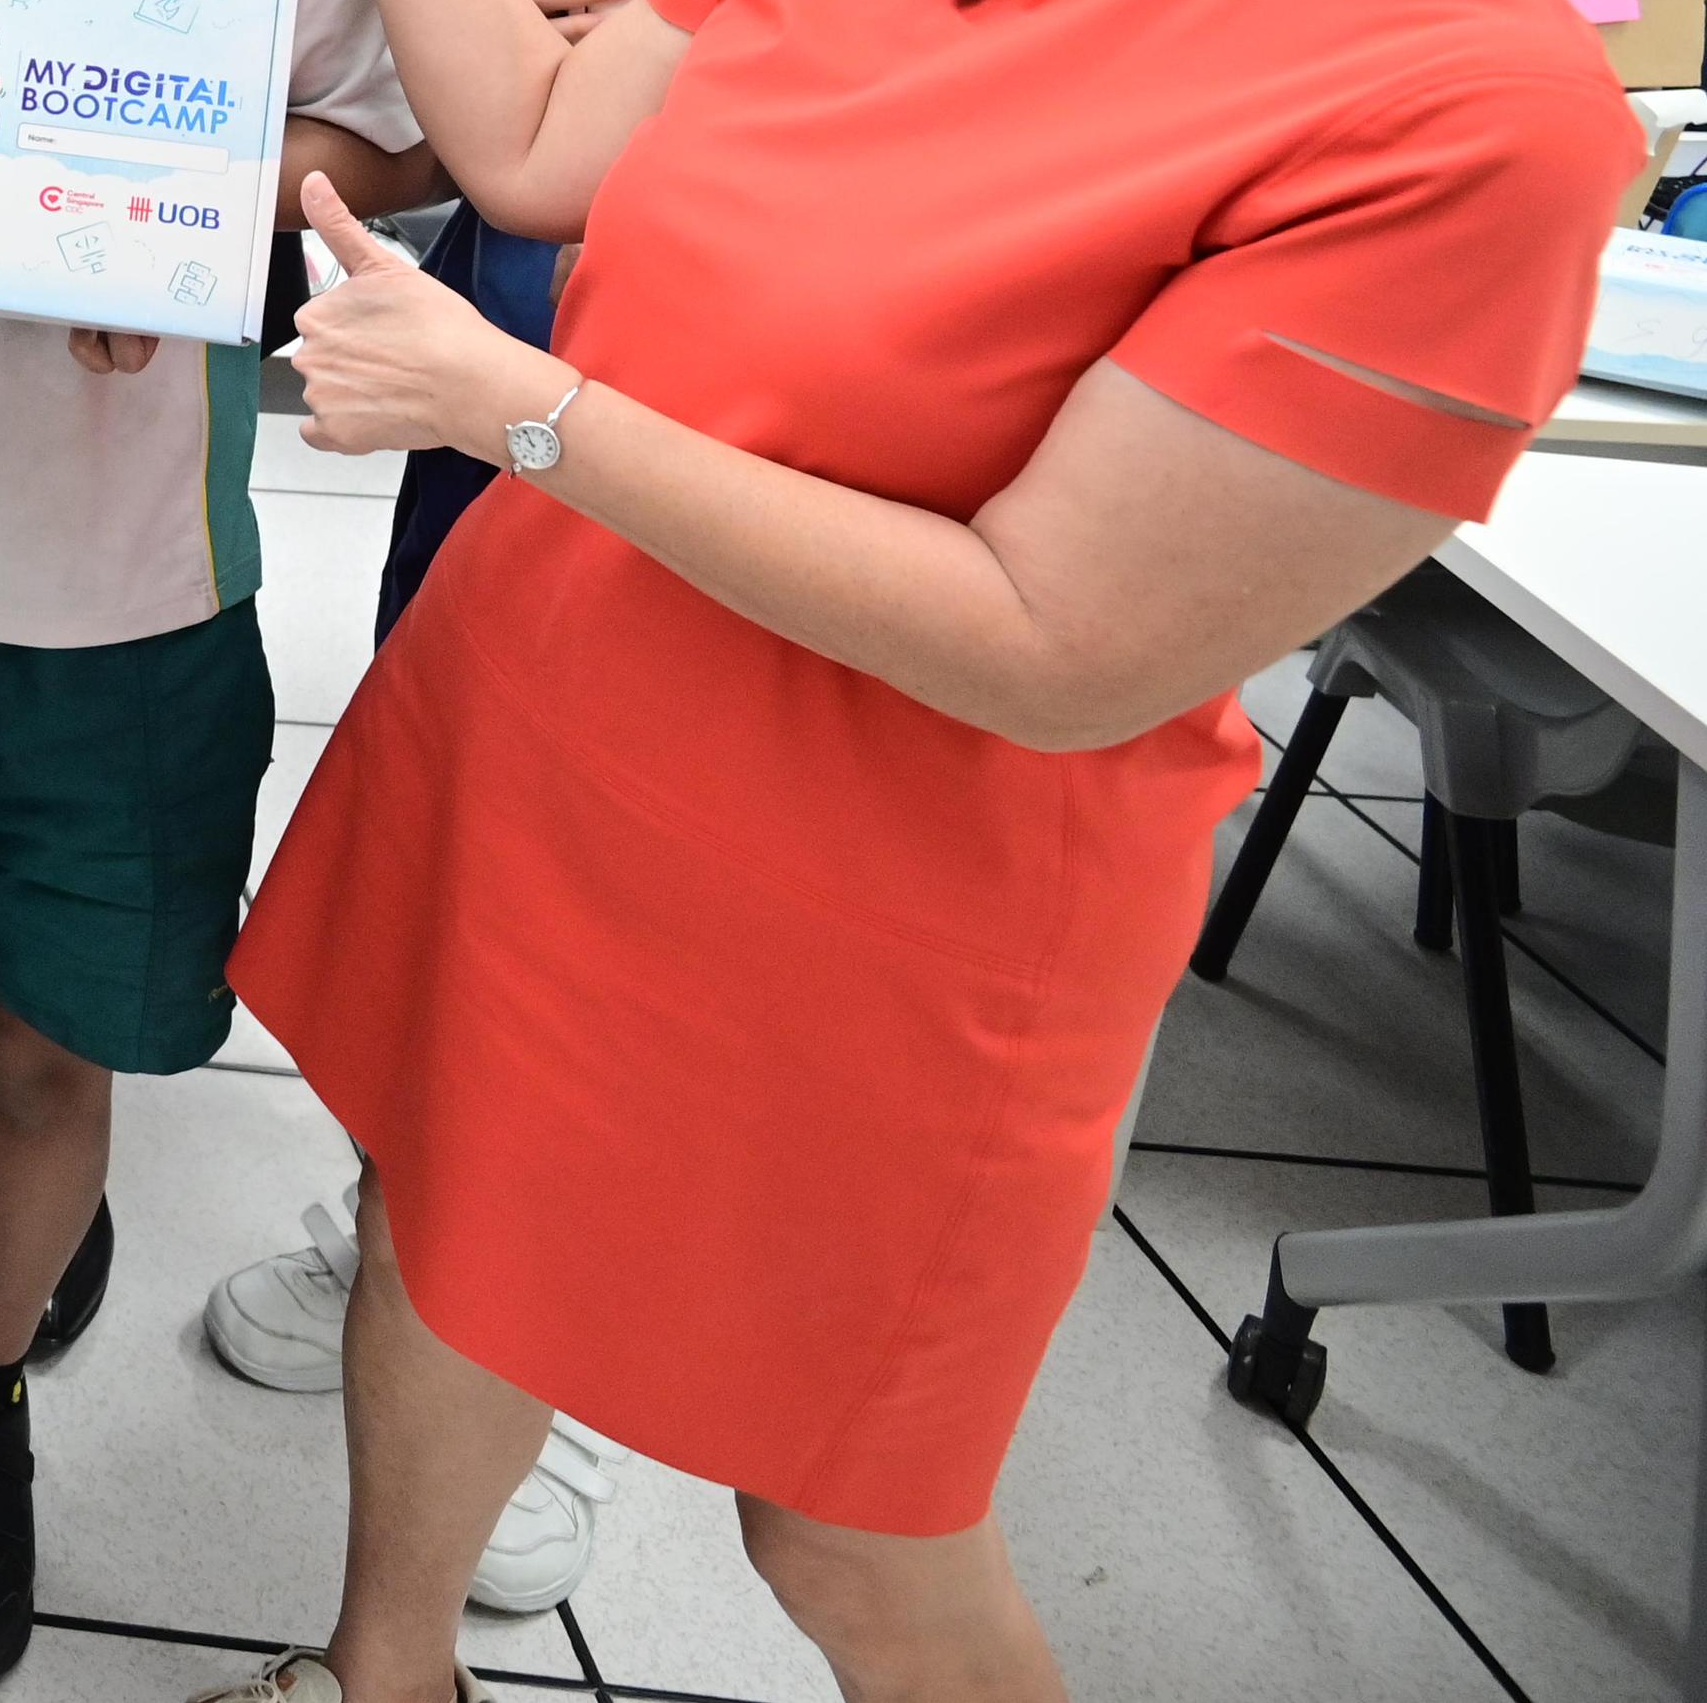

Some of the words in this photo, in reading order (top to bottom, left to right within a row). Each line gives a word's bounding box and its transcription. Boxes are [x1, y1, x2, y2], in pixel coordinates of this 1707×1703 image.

[24, 58, 75, 86] MY
[21, 87, 228, 133] BOOTCAMP
[158, 202, 220, 230] UOB
